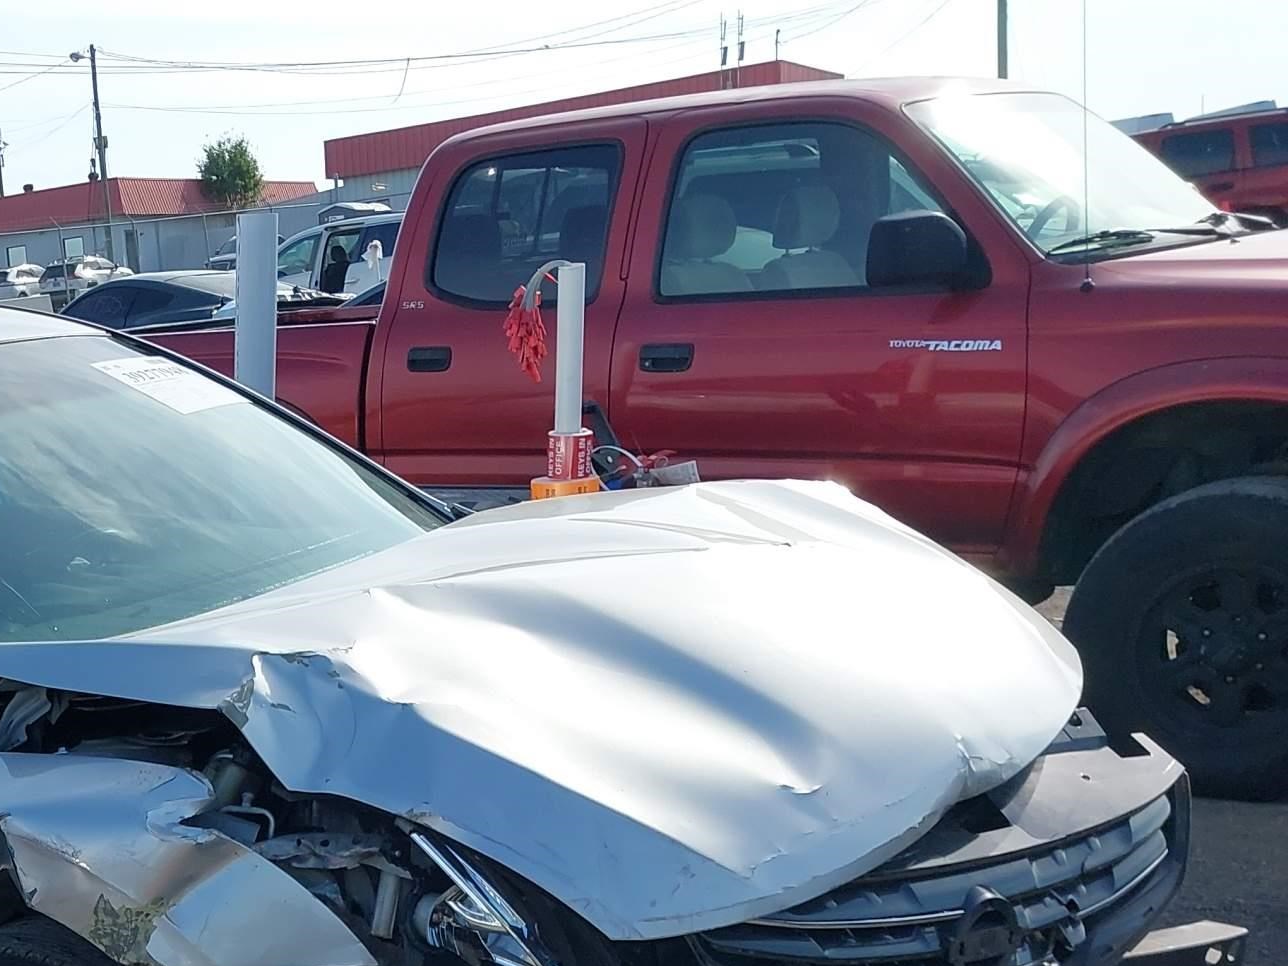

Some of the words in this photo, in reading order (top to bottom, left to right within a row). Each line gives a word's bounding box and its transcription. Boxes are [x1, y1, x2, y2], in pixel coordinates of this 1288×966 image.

[400, 300, 425, 310] SR5
[889, 339, 925, 348] TOYOTA
[926, 339, 1002, 351] TACOMA
[578, 438, 586, 449] IN
